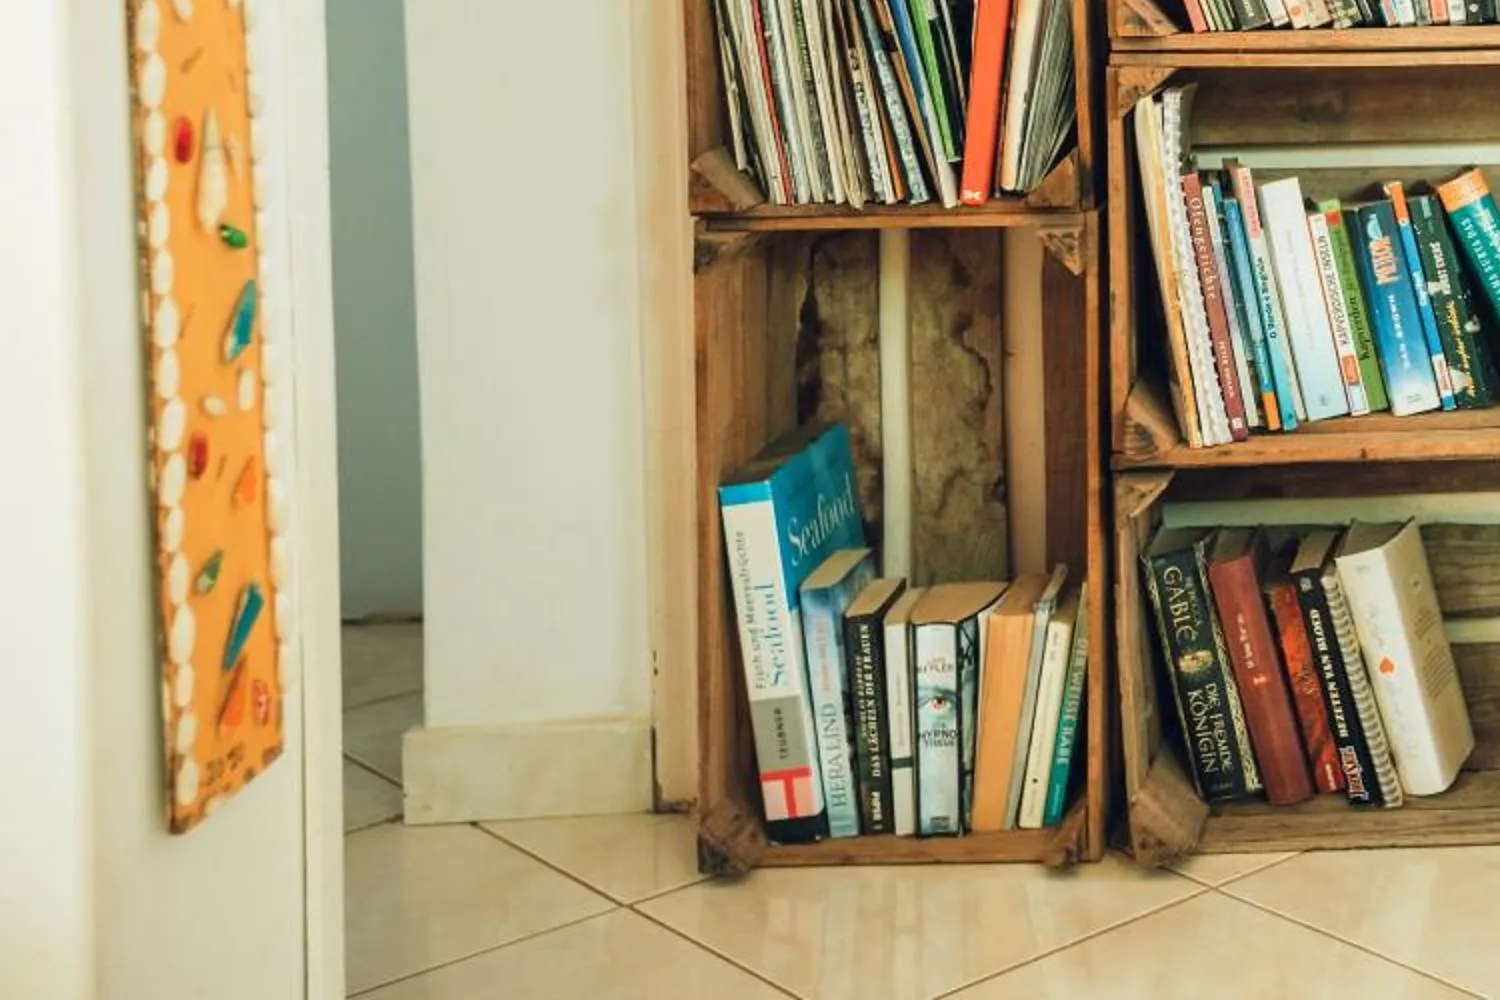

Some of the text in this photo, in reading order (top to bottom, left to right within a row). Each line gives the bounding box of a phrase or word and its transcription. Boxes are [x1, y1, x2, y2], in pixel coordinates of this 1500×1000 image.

[1191, 196, 1217, 302] Ofengerichte
[748, 628, 761, 651] und
[754, 583, 788, 690] Seafood
[859, 624, 882, 777] DAS LÄCHELN DER FRAUEN
[1204, 682, 1218, 709] DIE
[821, 703, 840, 751] LIND
[1187, 690, 1217, 774] KÖNIGIN
[1210, 711, 1233, 772] FREMDE
[828, 754, 848, 807] HERA
